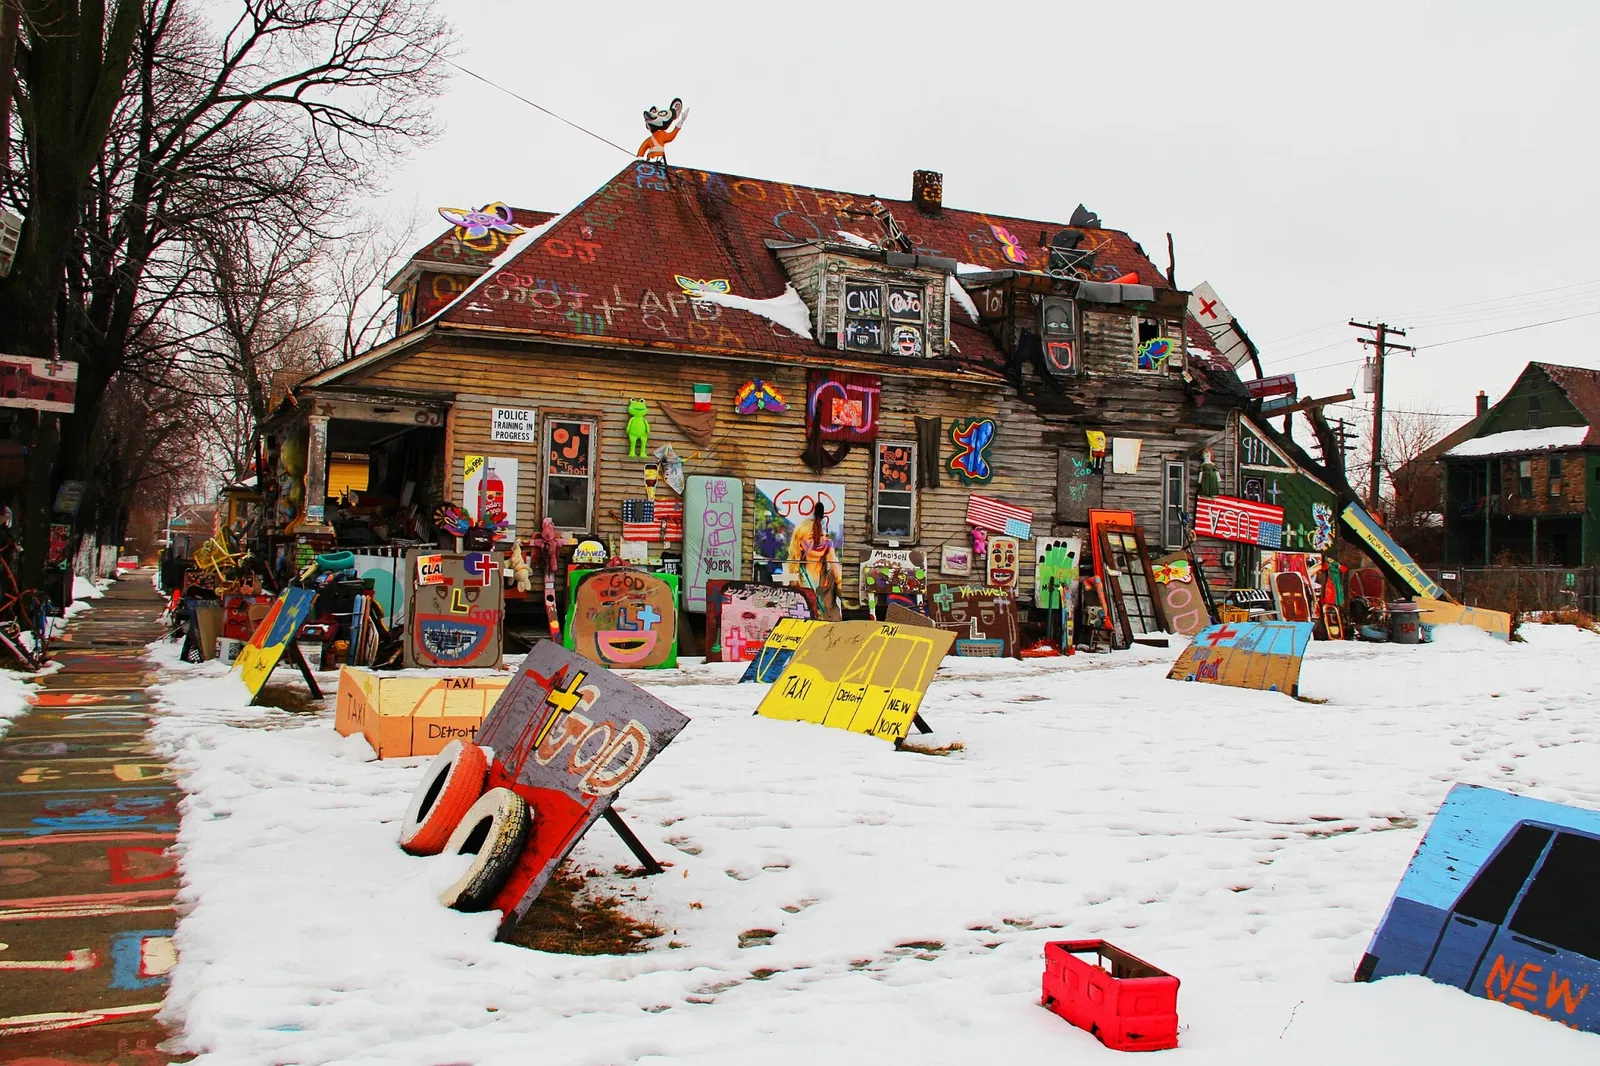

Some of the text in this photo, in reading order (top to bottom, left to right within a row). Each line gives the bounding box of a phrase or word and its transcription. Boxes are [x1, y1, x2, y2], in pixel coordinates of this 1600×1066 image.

[846, 289, 879, 312] CNN
[498, 409, 529, 421] POLICE
[494, 421, 534, 431] TRAINING IN
[495, 430, 530, 441] PROGRESS
[1366, 533, 1382, 551] NEW
[706, 548, 732, 556] NEW
[610, 573, 644, 590] GOD
[443, 678, 474, 689] TAXI
[887, 699, 911, 714] NEW
[1485, 954, 1590, 1015] NEW
